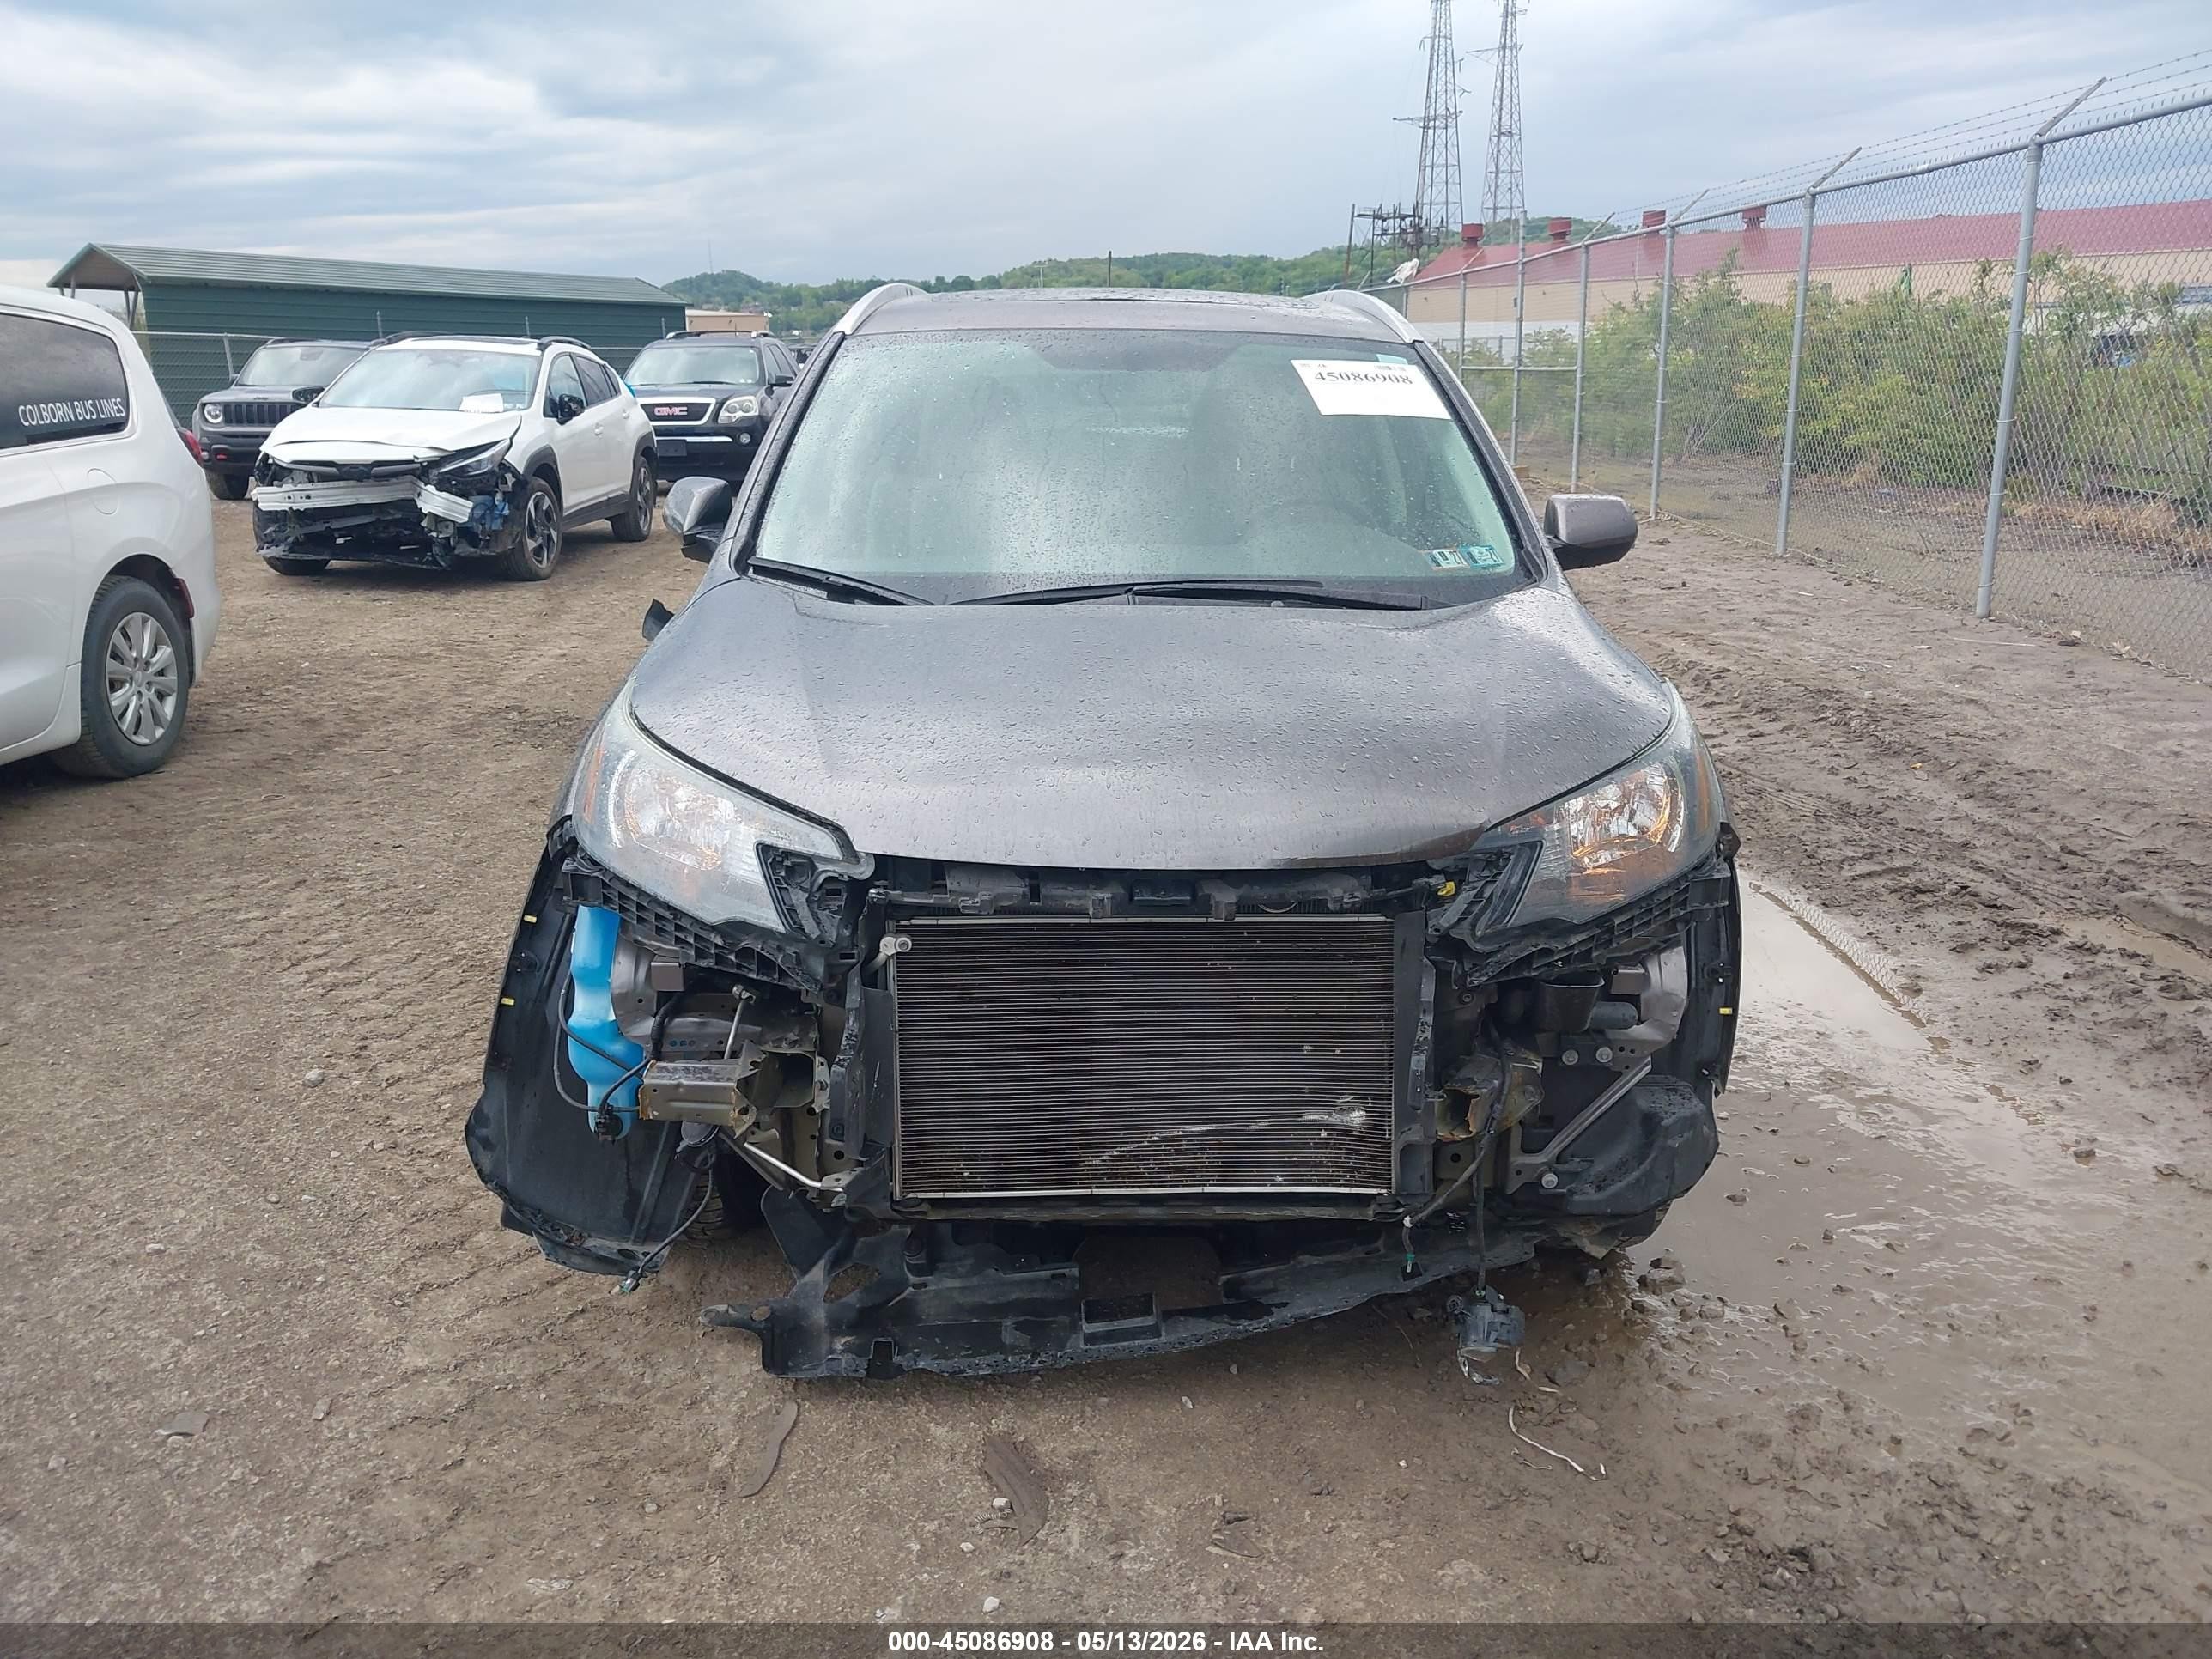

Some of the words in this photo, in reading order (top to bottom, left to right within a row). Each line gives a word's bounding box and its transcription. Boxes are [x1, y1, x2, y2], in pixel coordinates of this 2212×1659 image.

[1315, 371, 1413, 385] 45086908
[18, 402, 75, 426] COLBORN
[74, 399, 96, 420] BUS
[96, 398, 125, 417] LINES
[653, 407, 688, 416] GMC
